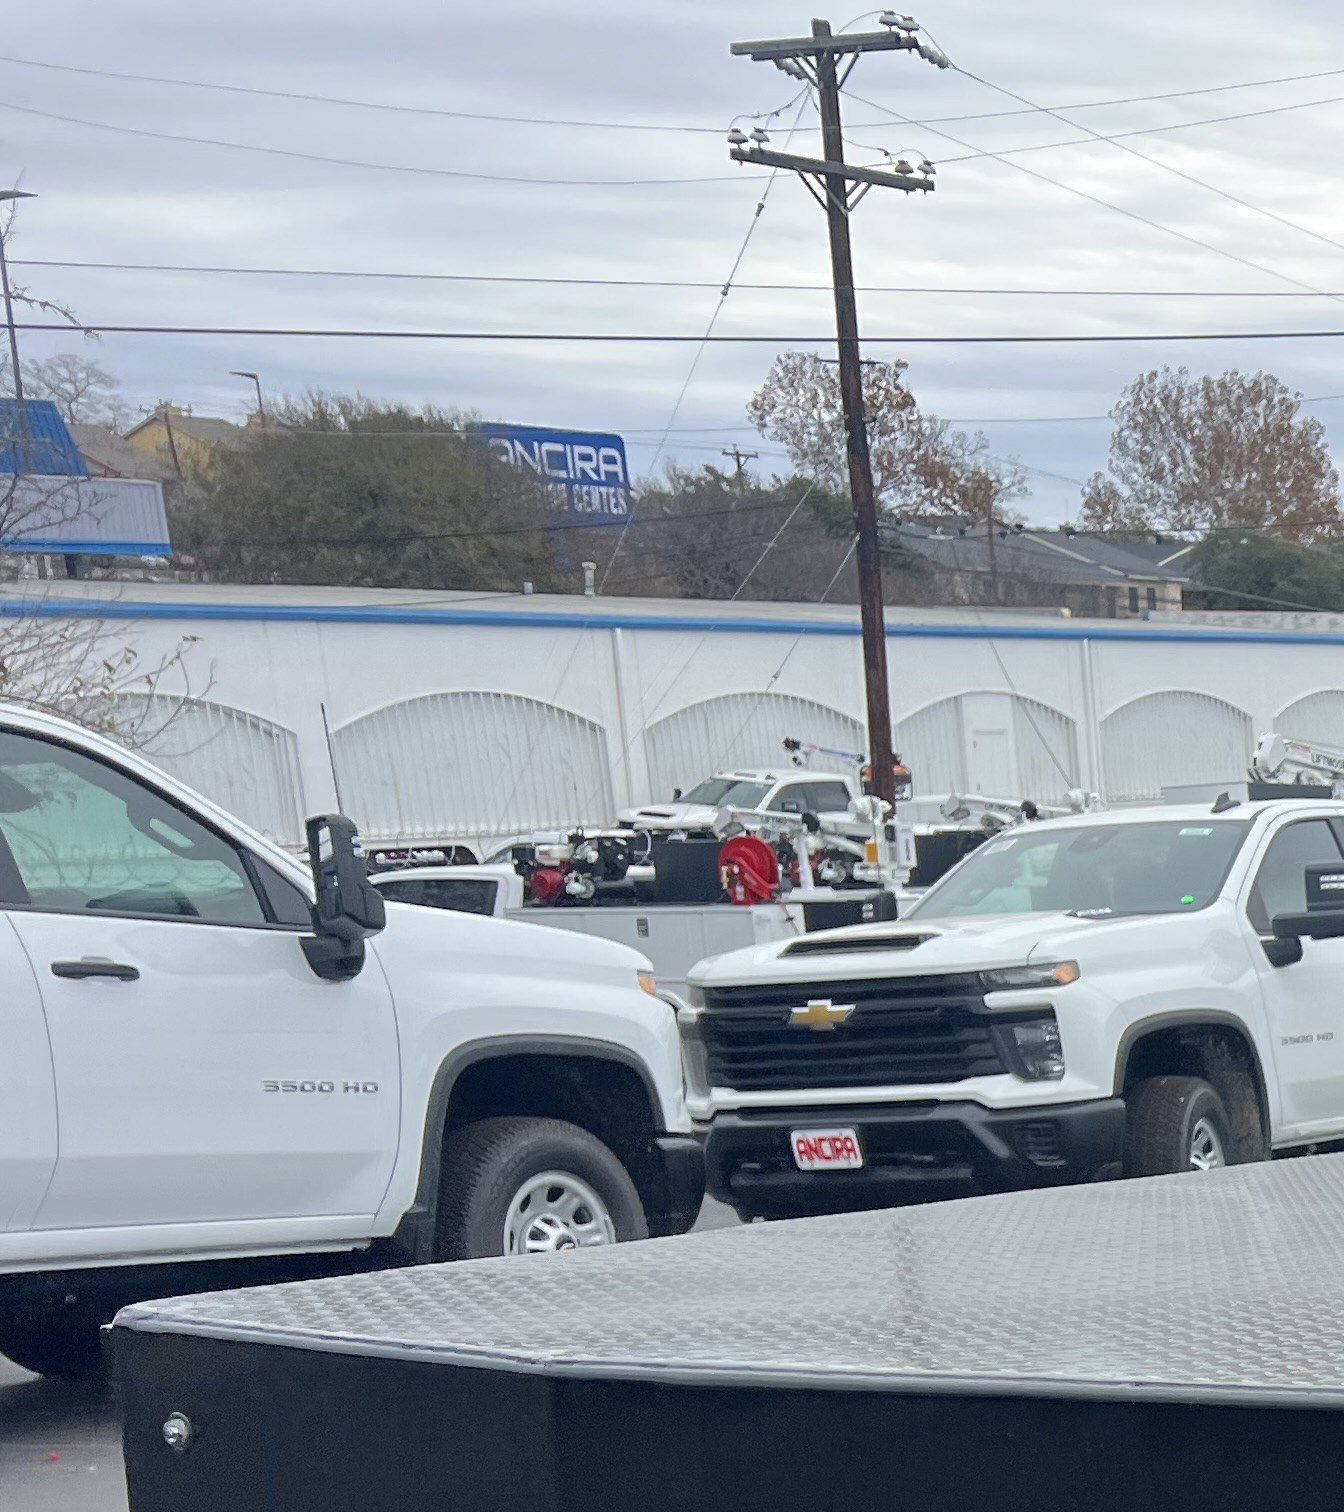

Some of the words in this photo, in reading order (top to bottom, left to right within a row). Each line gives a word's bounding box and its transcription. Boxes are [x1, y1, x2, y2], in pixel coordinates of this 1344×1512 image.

[262, 1080, 334, 1093] 3500
[343, 1081, 379, 1093] HD
[796, 1137, 858, 1161] ANCIRA
